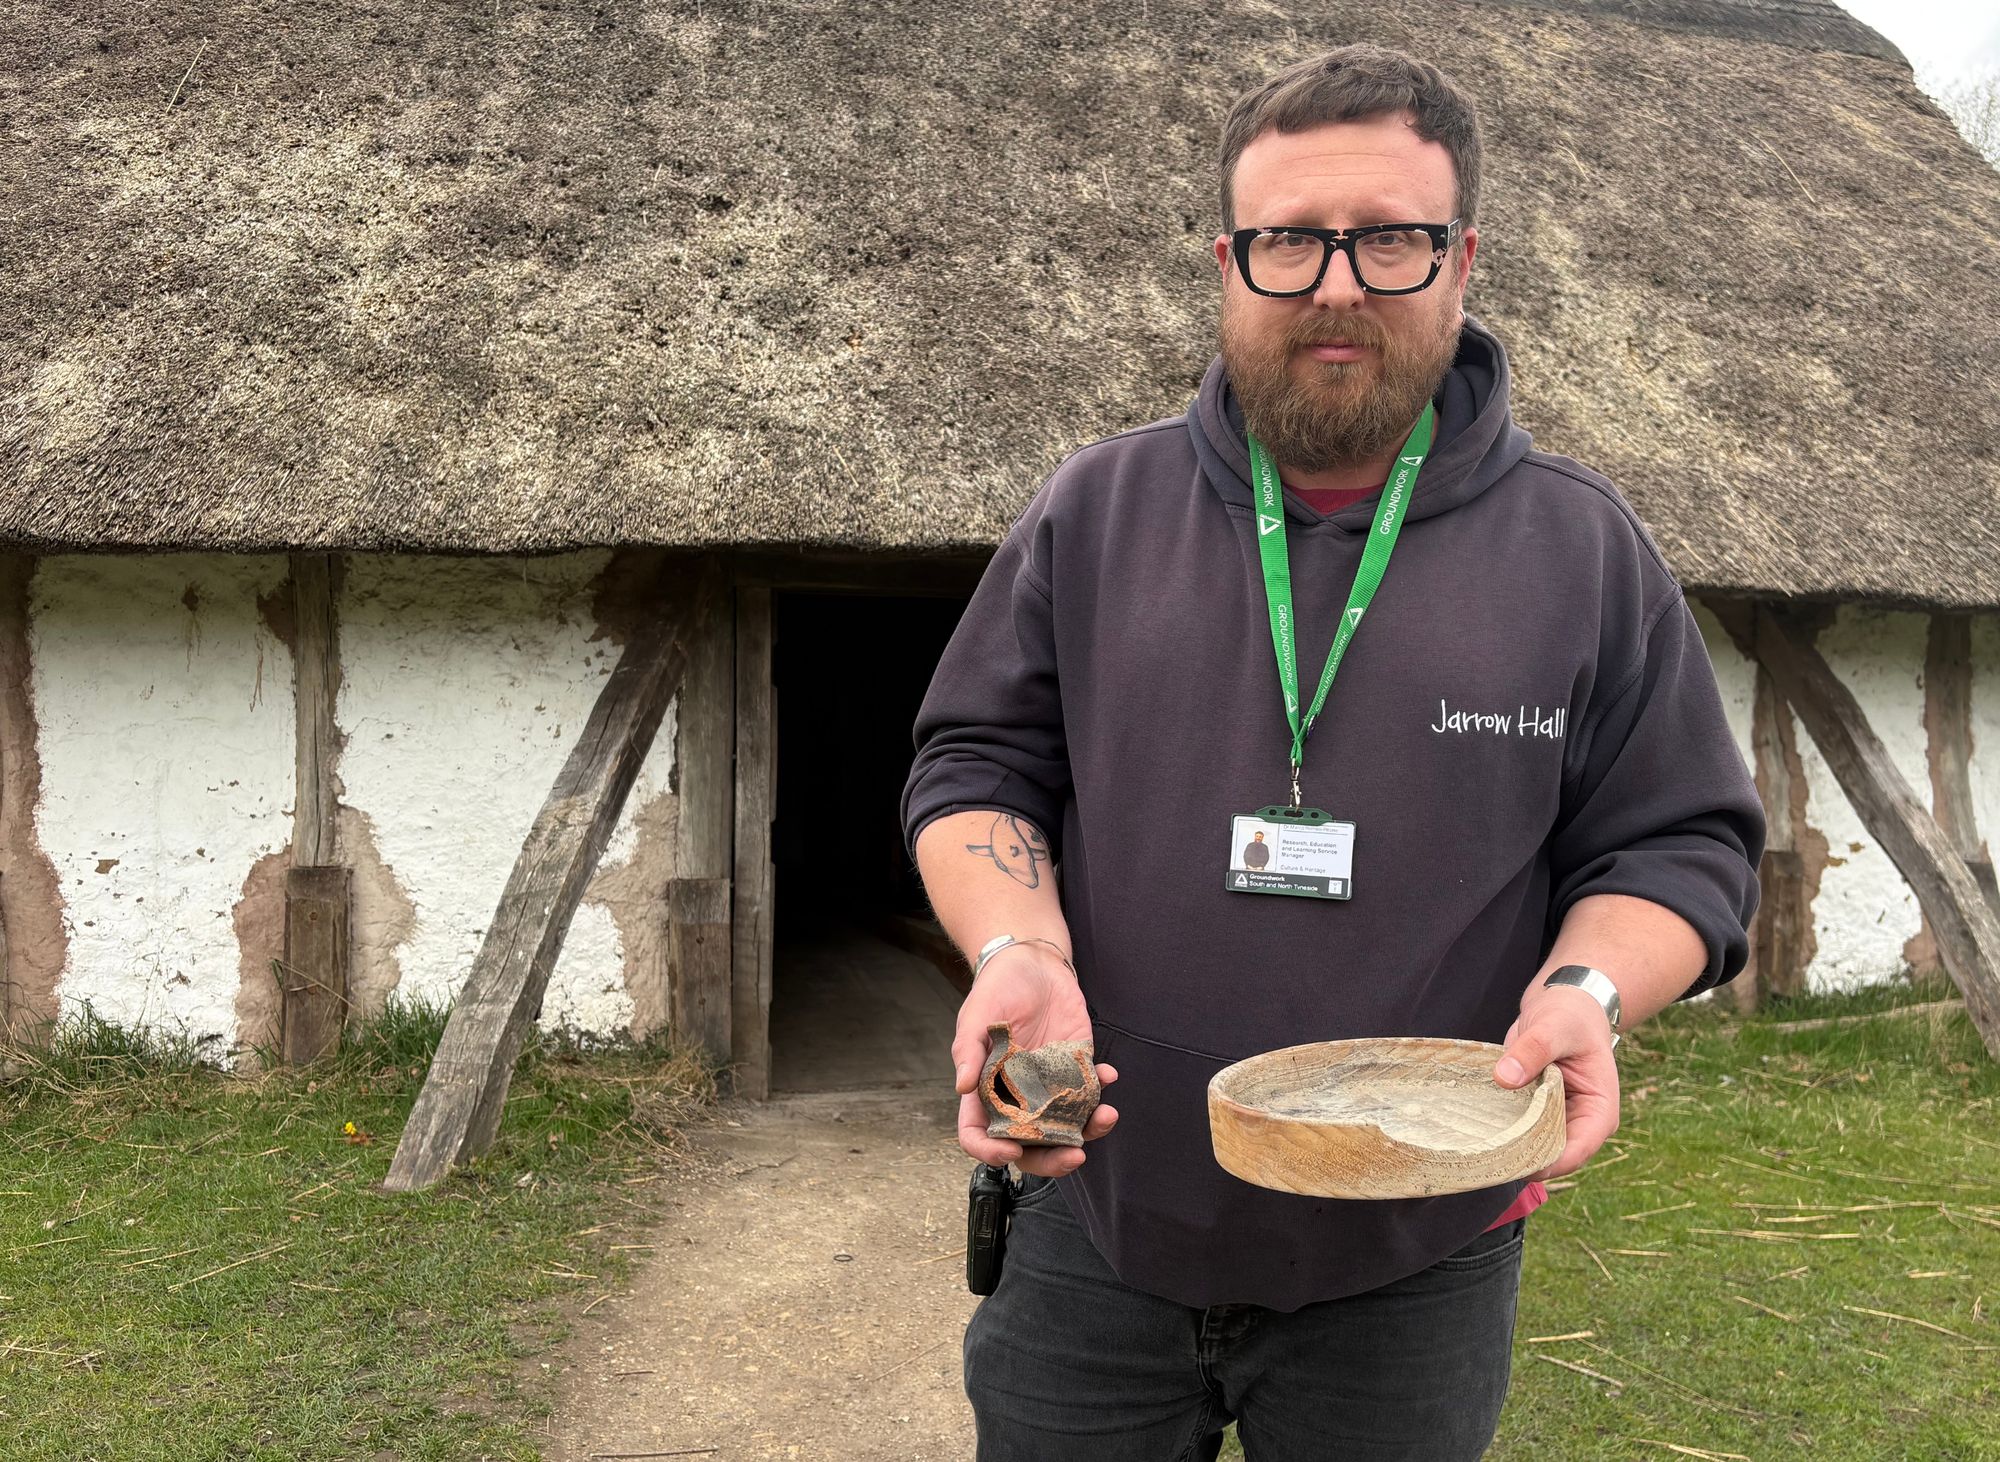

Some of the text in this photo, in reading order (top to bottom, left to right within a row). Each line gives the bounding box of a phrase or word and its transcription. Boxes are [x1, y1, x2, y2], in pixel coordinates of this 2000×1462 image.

[1380, 468, 1410, 535] GROUNDWORK
[1277, 604, 1293, 686] GROUNDWORK
[1431, 698, 1566, 739] Jarrow Hall
[1249, 873, 1285, 882] Groundwork
[1249, 880, 1265, 888] South
